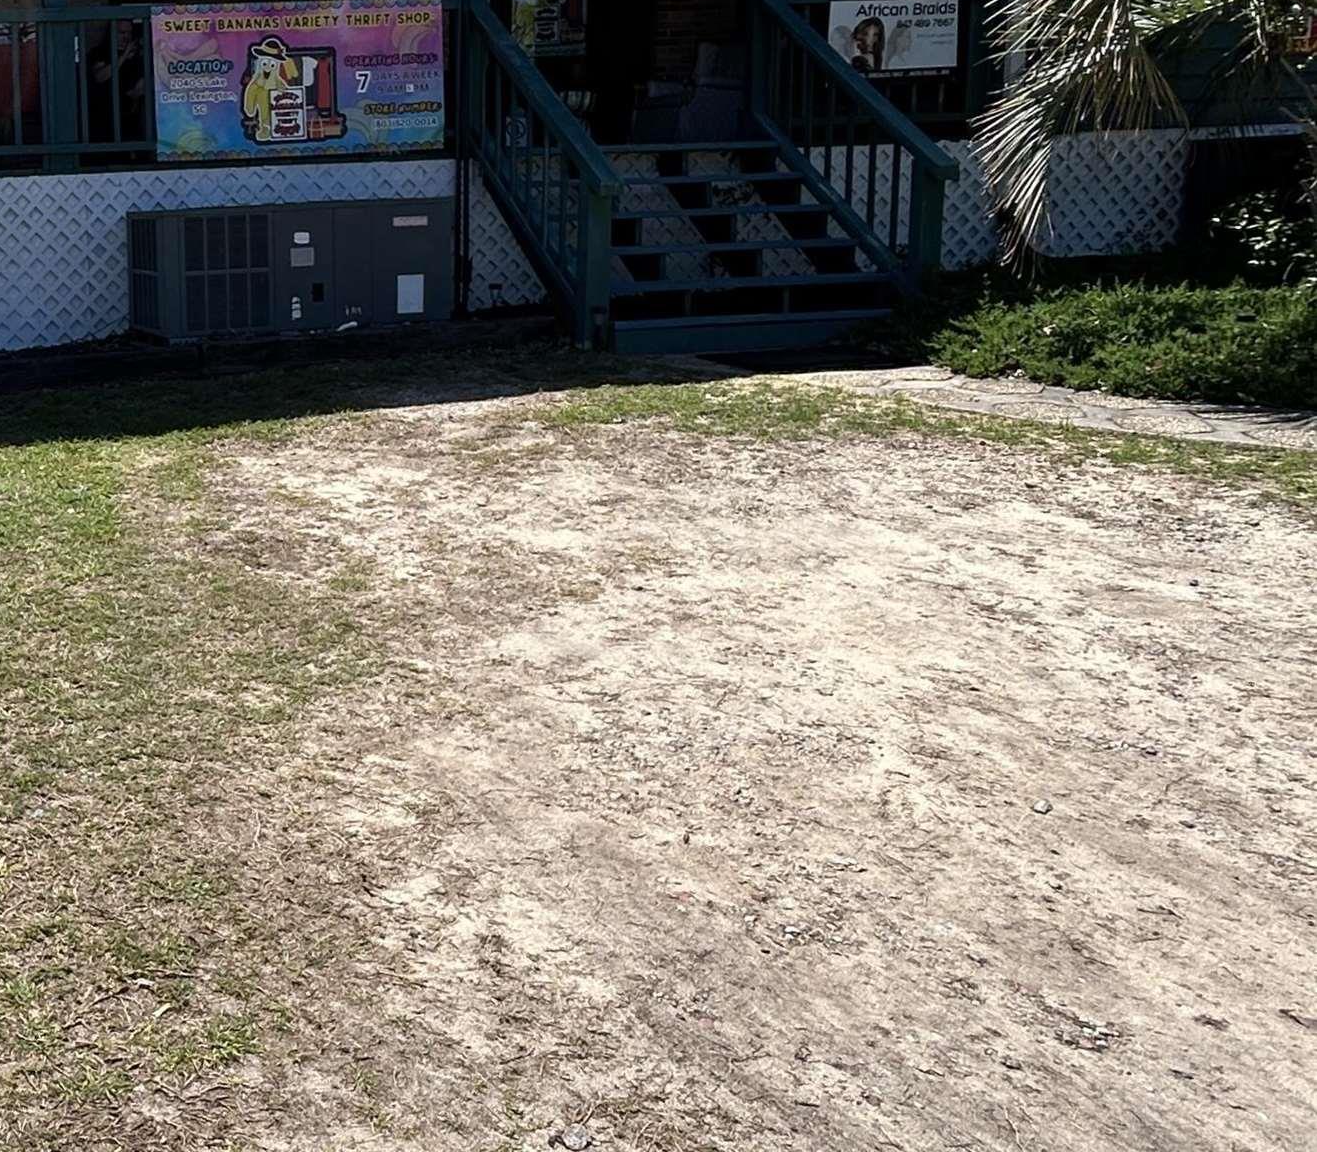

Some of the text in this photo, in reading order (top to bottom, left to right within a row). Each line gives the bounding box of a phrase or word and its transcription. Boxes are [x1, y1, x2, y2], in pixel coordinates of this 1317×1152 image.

[856, 1, 956, 16] African Braids
[164, 12, 431, 32] SWEET BANANAS VARIETY THRIFT SHOP
[355, 70, 371, 93] 7
